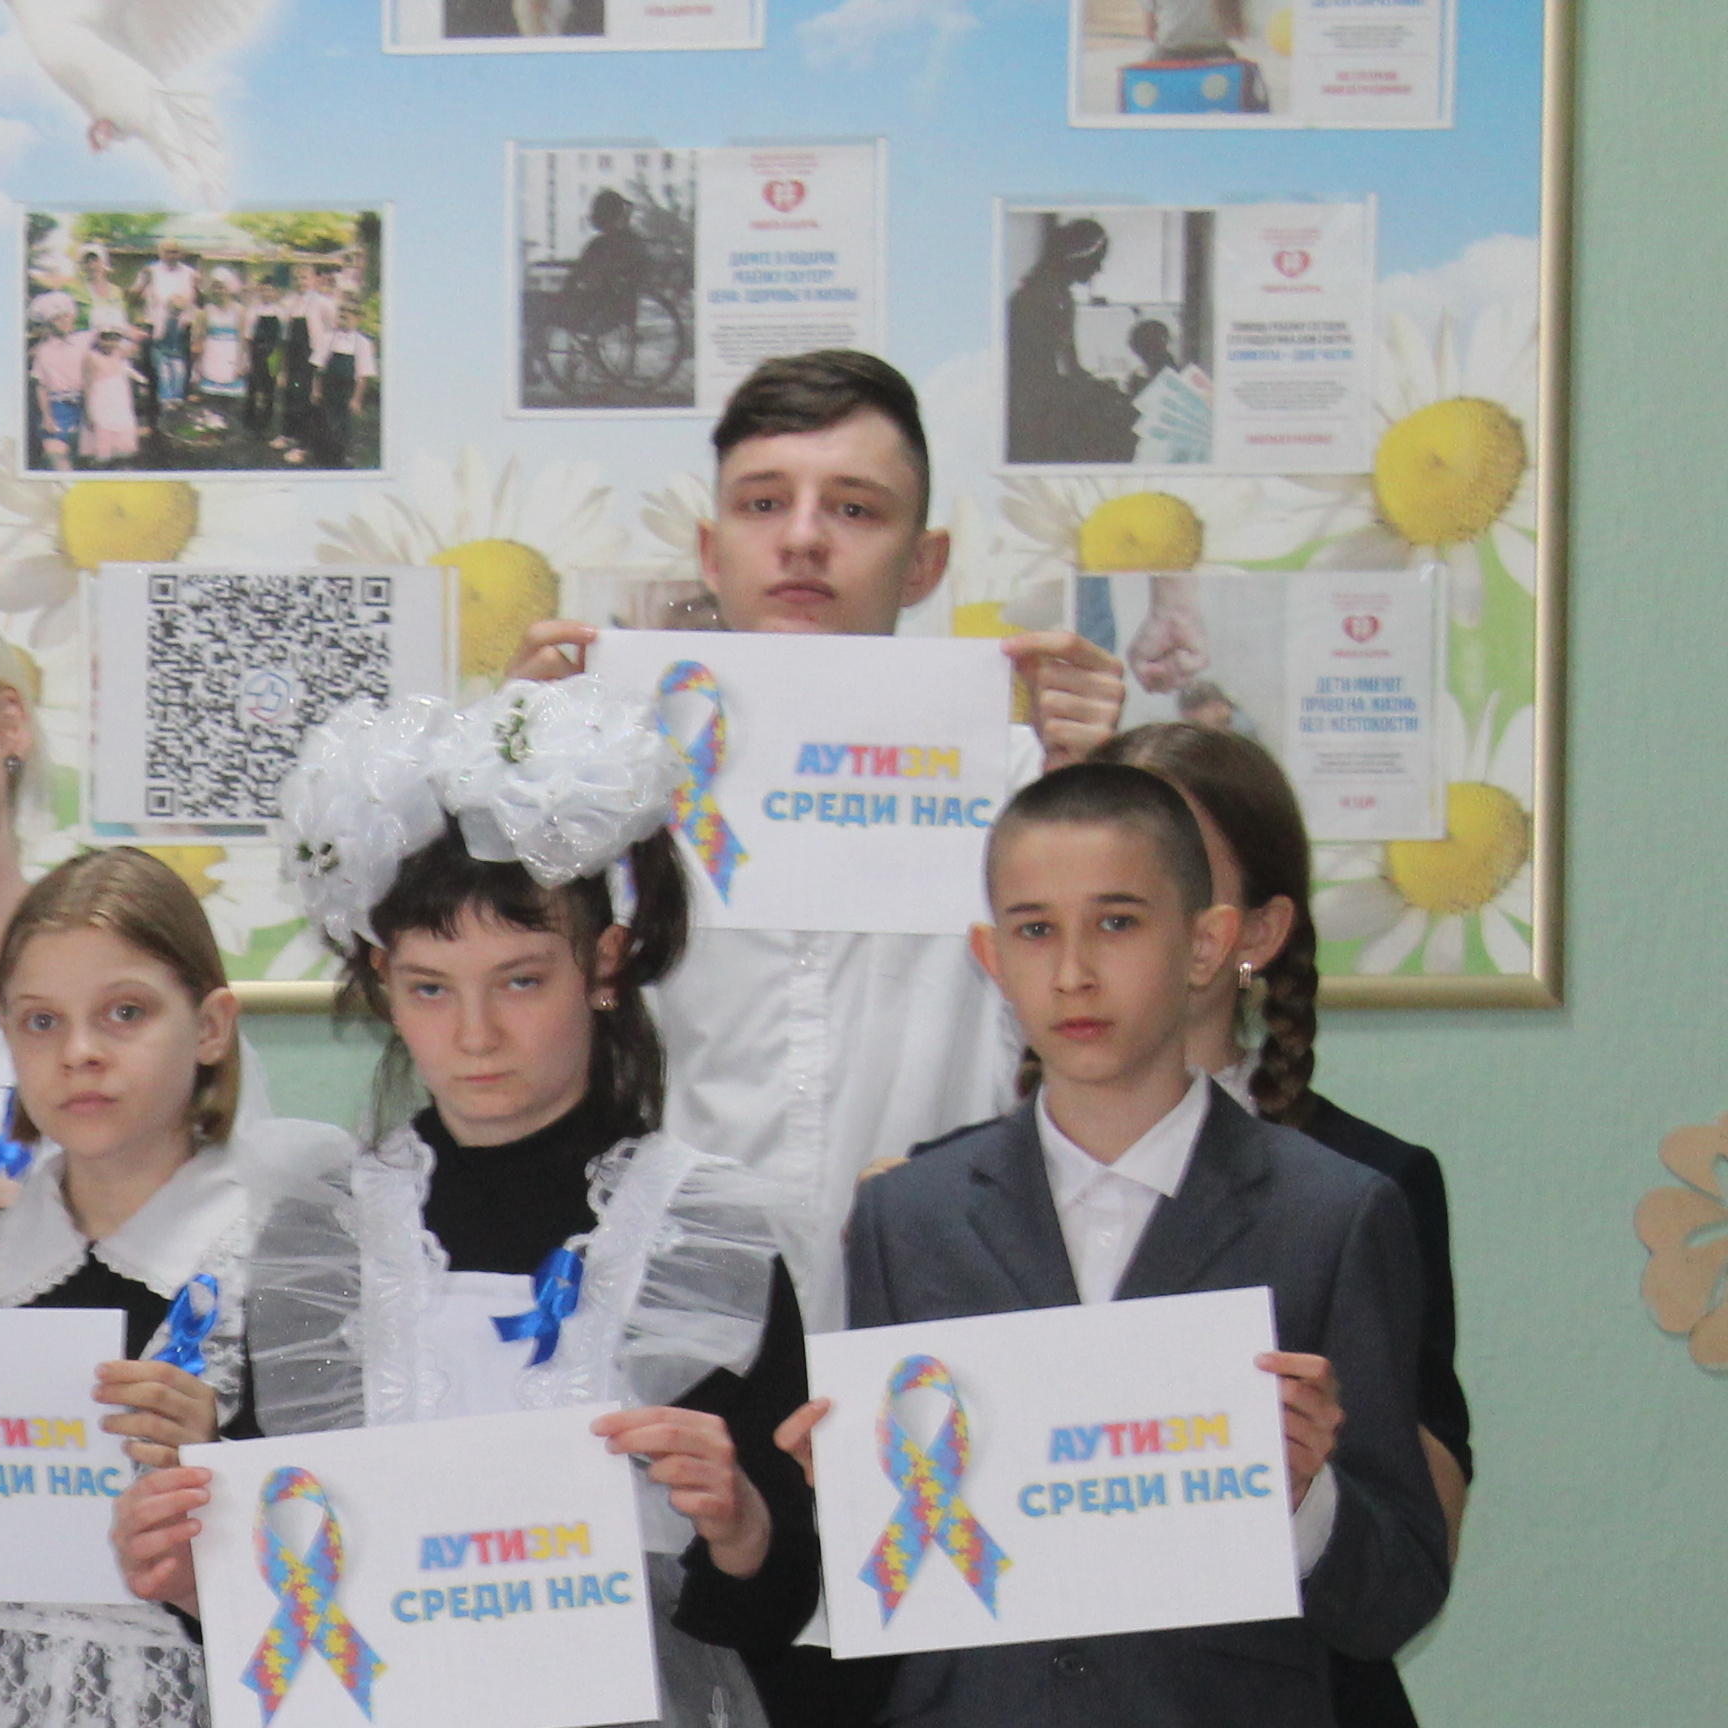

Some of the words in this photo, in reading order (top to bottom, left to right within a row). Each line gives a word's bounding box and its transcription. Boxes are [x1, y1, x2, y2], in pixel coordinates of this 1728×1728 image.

[797, 744, 960, 778] АУТИЗМ
[765, 792, 897, 826] СРЕДИ
[913, 797, 993, 828] НАС
[1050, 1414, 1229, 1463] АУТИЗМ
[48, 1466, 121, 1497] НАС
[1019, 1475, 1166, 1518] СРЕДИ
[1182, 1465, 1272, 1503] НАС
[420, 1523, 592, 1570] АУТИЗМ
[391, 1580, 533, 1624] СРЕДИ
[548, 1572, 631, 1608] НАС
